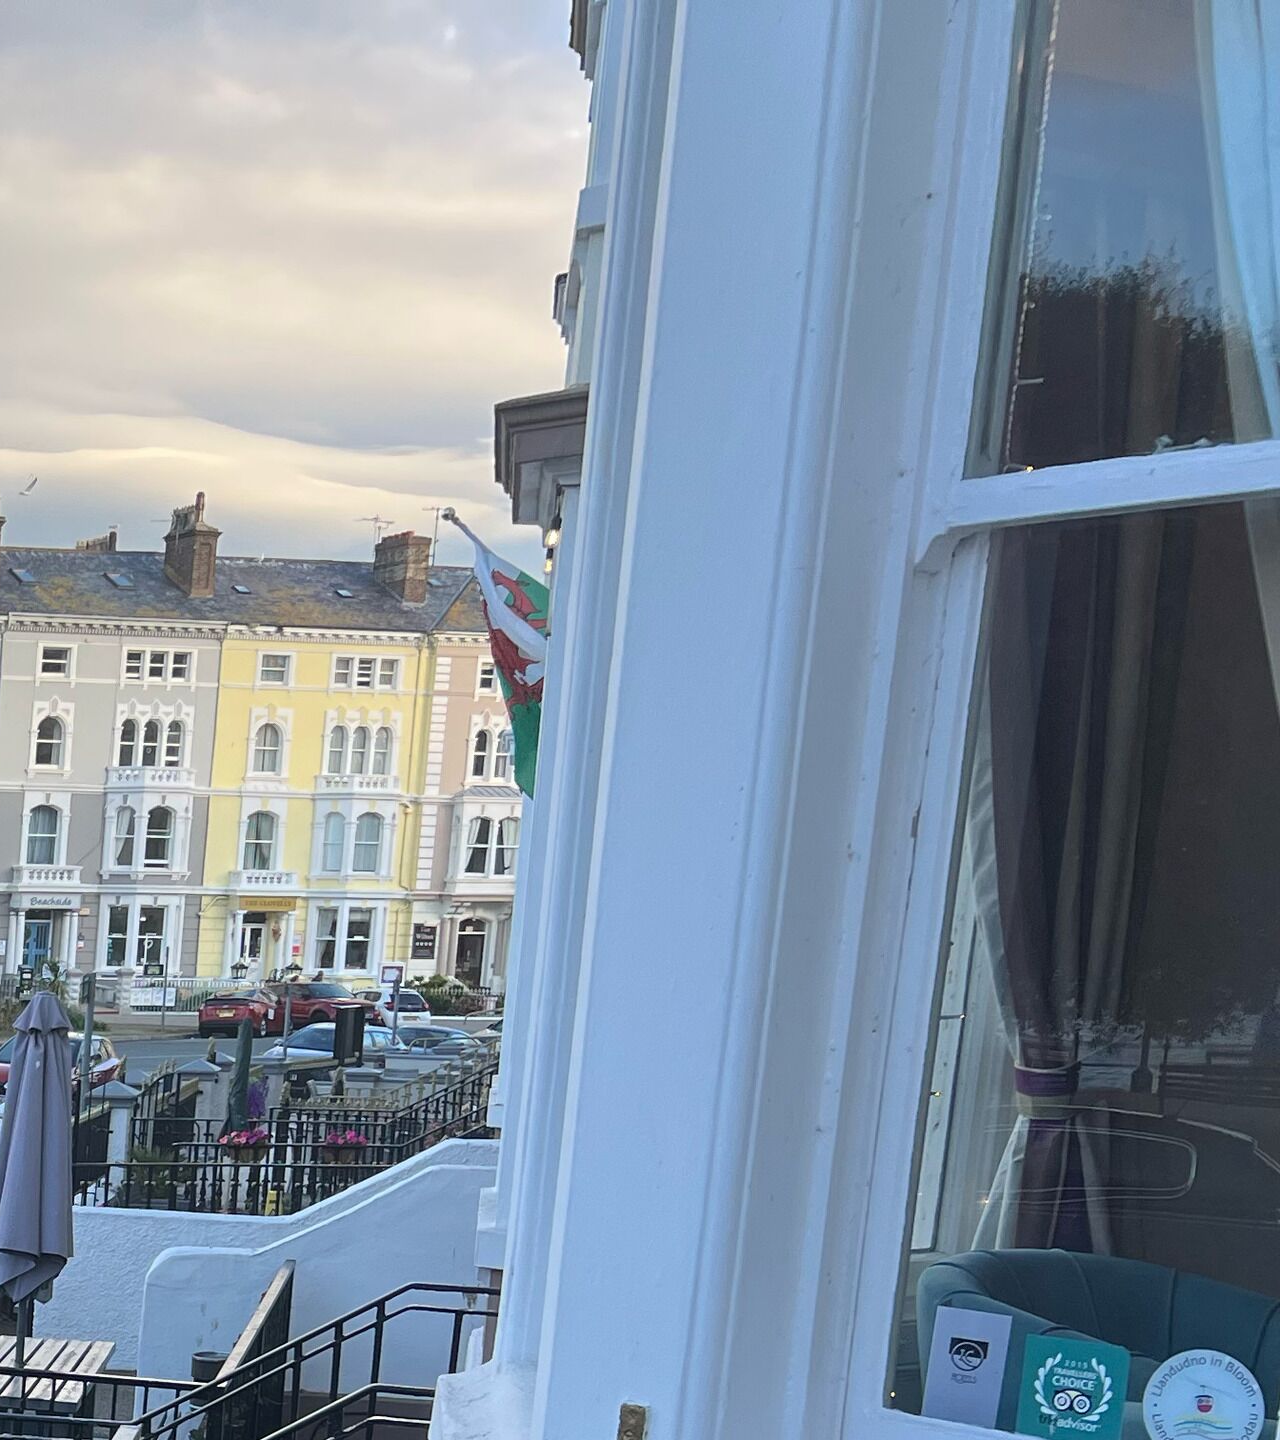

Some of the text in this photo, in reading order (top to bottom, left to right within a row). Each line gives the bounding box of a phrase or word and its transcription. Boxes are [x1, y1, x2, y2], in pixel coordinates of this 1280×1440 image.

[1052, 1375, 1096, 1391] CHOICE
[1151, 1356, 1256, 1397] Llandudno in Bloom
